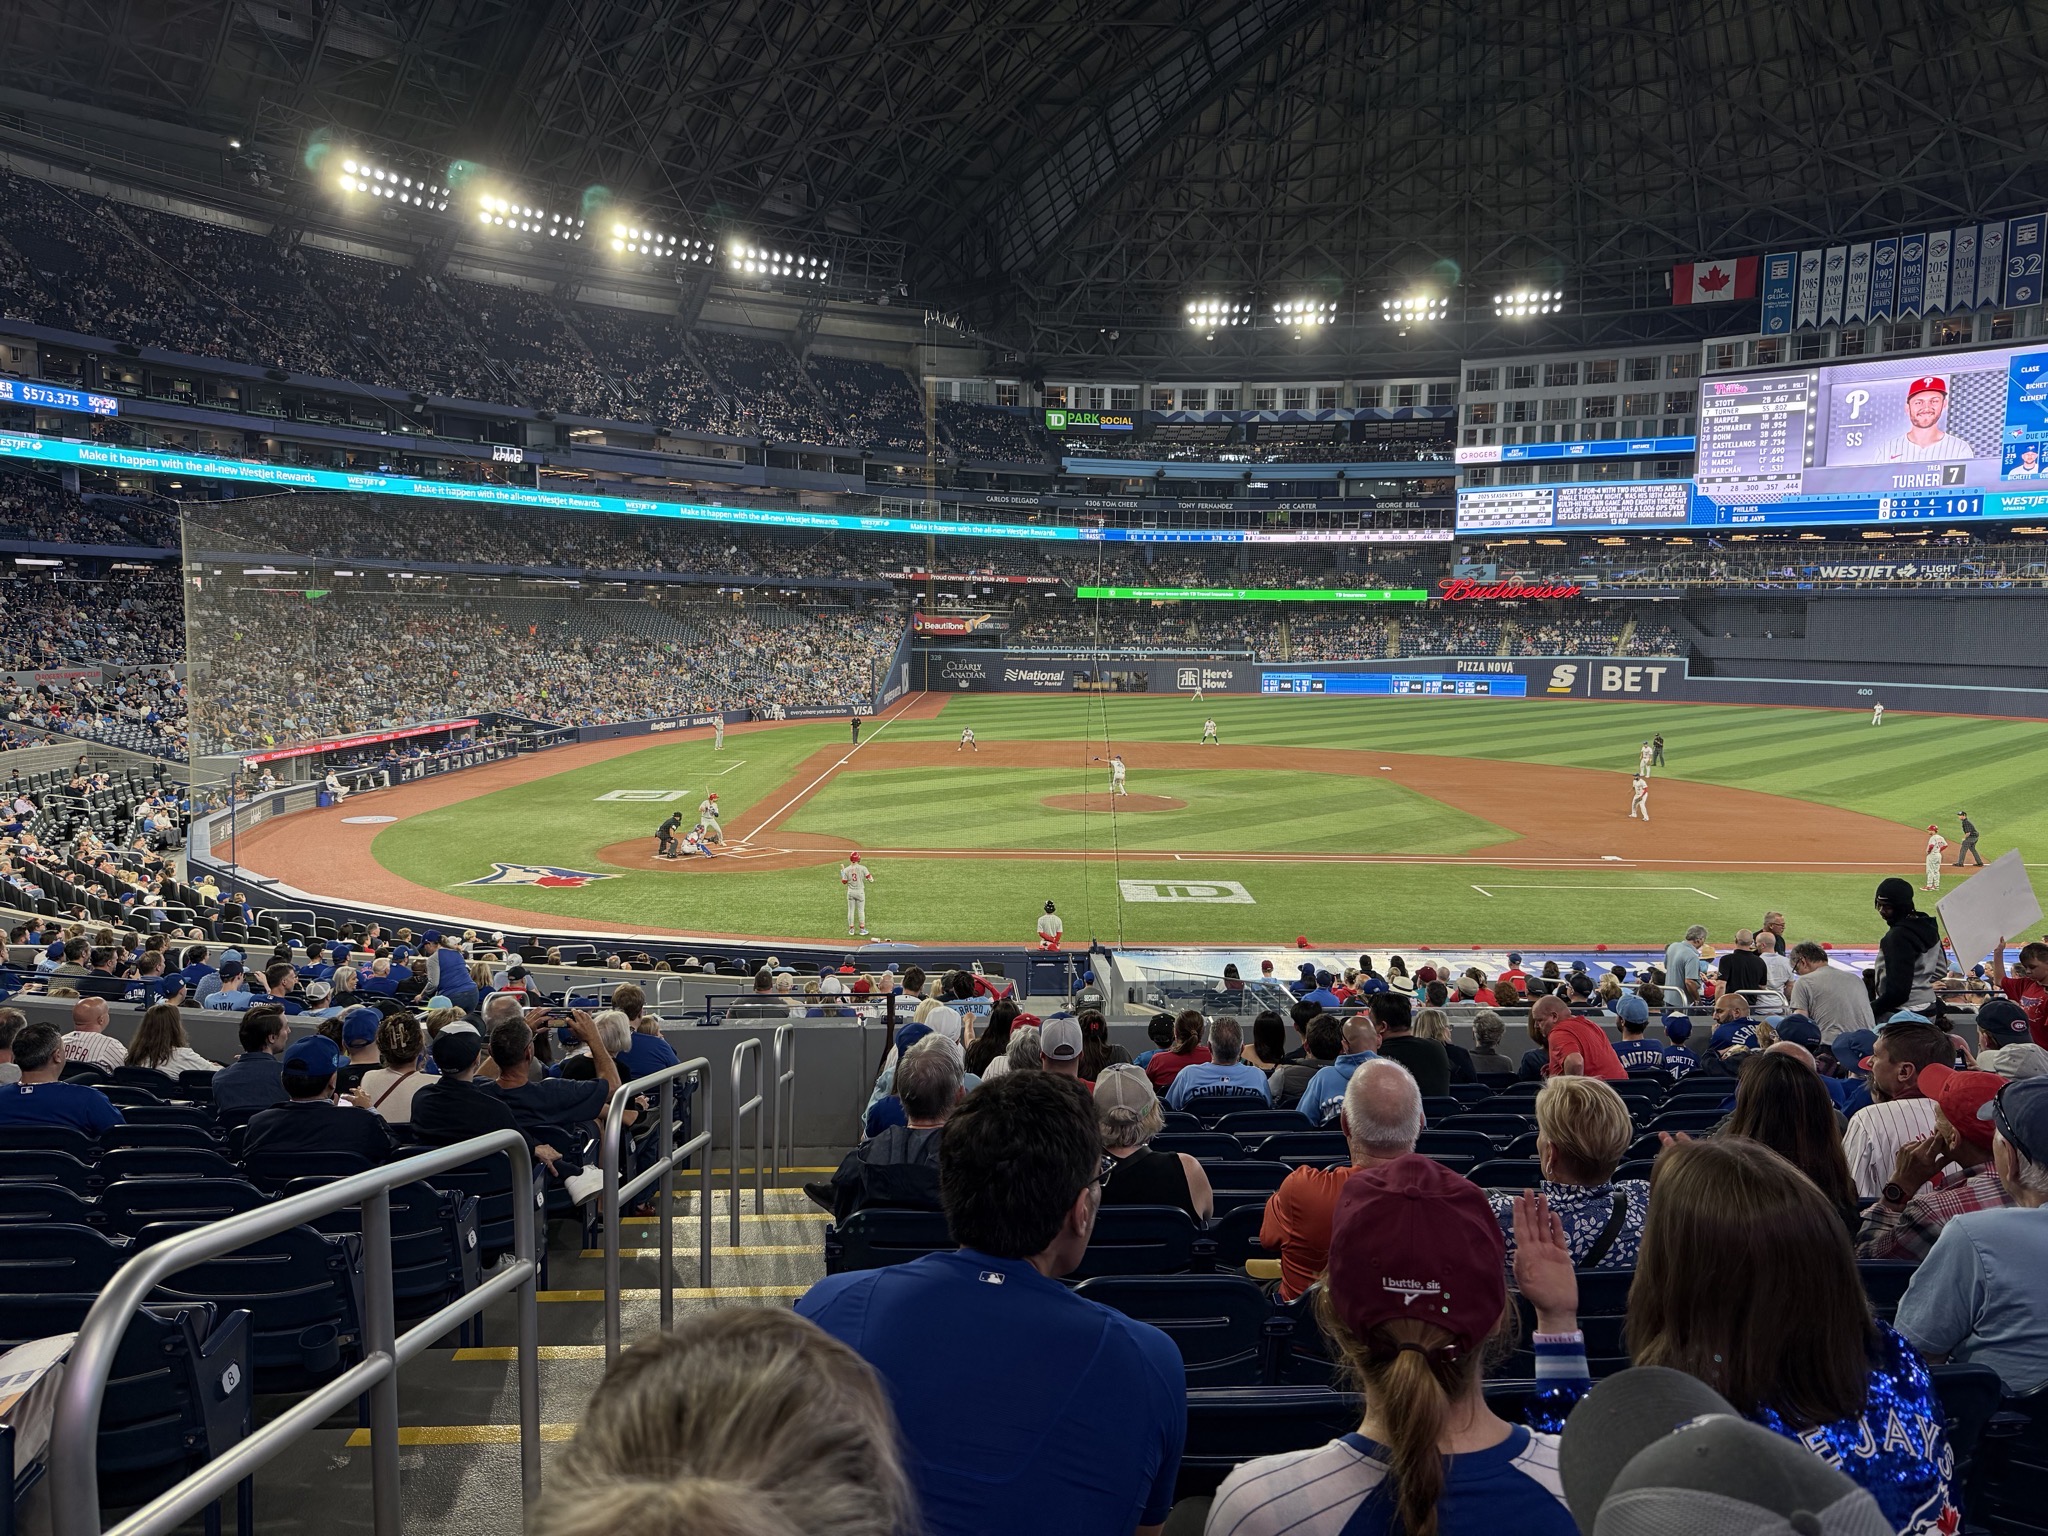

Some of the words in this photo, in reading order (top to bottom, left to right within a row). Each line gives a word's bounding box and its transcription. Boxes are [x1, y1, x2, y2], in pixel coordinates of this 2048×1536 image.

[1928, 261, 1948, 273] 2015
[1955, 257, 1974, 269] 2016
[2009, 254, 2041, 278] 32
[1876, 269, 1892, 281] 1992
[1903, 264, 1920, 276] 1993
[1802, 278, 1818, 290] 1985
[1826, 275, 1842, 287] 1989
[1851, 272, 1866, 284] 1991
[1825, 288, 1841, 296] A.L.
[1850, 286, 1866, 294] A.L.
[1800, 300, 1816, 308] EAST
[1825, 298, 1840, 306] EAST
[1848, 295, 1865, 304] EAST
[1901, 295, 1919, 303] CHAMPS
[23, 386, 79, 406] $573,375
[1048, 414, 1064, 426] TD
[1068, 413, 1099, 423] PARK
[1714, 424, 1751, 432] SCHWARBER
[0, 439, 32, 450] ESTJET
[1846, 432, 1863, 448] SS
[492, 449, 522, 464] KPMG
[80, 448, 108, 462] Make
[110, 452, 118, 462] it
[120, 454, 158, 468] happen
[161, 457, 184, 470] with
[186, 458, 202, 472] the
[204, 460, 238, 475] all-new
[240, 465, 274, 481] WestJet
[276, 468, 318, 483] Rewards.
[347, 476, 378, 487] WESTJET
[1892, 473, 1940, 488] TURNER
[1949, 467, 1959, 483] 7
[414, 484, 437, 495] Make
[438, 485, 444, 495] it
[446, 486, 476, 499] happen
[477, 488, 494, 498] with
[496, 490, 509, 500] the
[510, 492, 537, 502] all-new
[538, 494, 567, 506] WestJet
[568, 497, 602, 508] Rewards.
[1011, 496, 1039, 504] DELGADO
[2001, 496, 2048, 507] WESTJET
[1819, 565, 1897, 579] WESTJET
[1920, 564, 1958, 573] FLIGHT
[1438, 577, 1580, 600] Budweiser
[947, 661, 981, 671] CLEARLY
[1457, 660, 1485, 672] PIZZA
[1487, 662, 1514, 673] NOVA
[942, 670, 986, 678] CANADIAN
[1202, 668, 1233, 679] Here's
[1550, 664, 1578, 688] S
[1602, 666, 1667, 692] BET
[1202, 679, 1227, 689] How.
[853, 706, 873, 715] VISA
[679, 719, 688, 727] BET
[1132, 883, 1233, 898] TD
[213, 1002, 234, 1011] KIRK
[1622, 1051, 1662, 1069] AUTISTA
[1666, 1055, 1694, 1067] BICHETTE
[1382, 1277, 1386, 1286] I
[1388, 1277, 1424, 1290] buttle,
[1426, 1280, 1440, 1289] sir.
[228, 1371, 235, 1386] 8
[1854, 1406, 1955, 1481] JAYS
